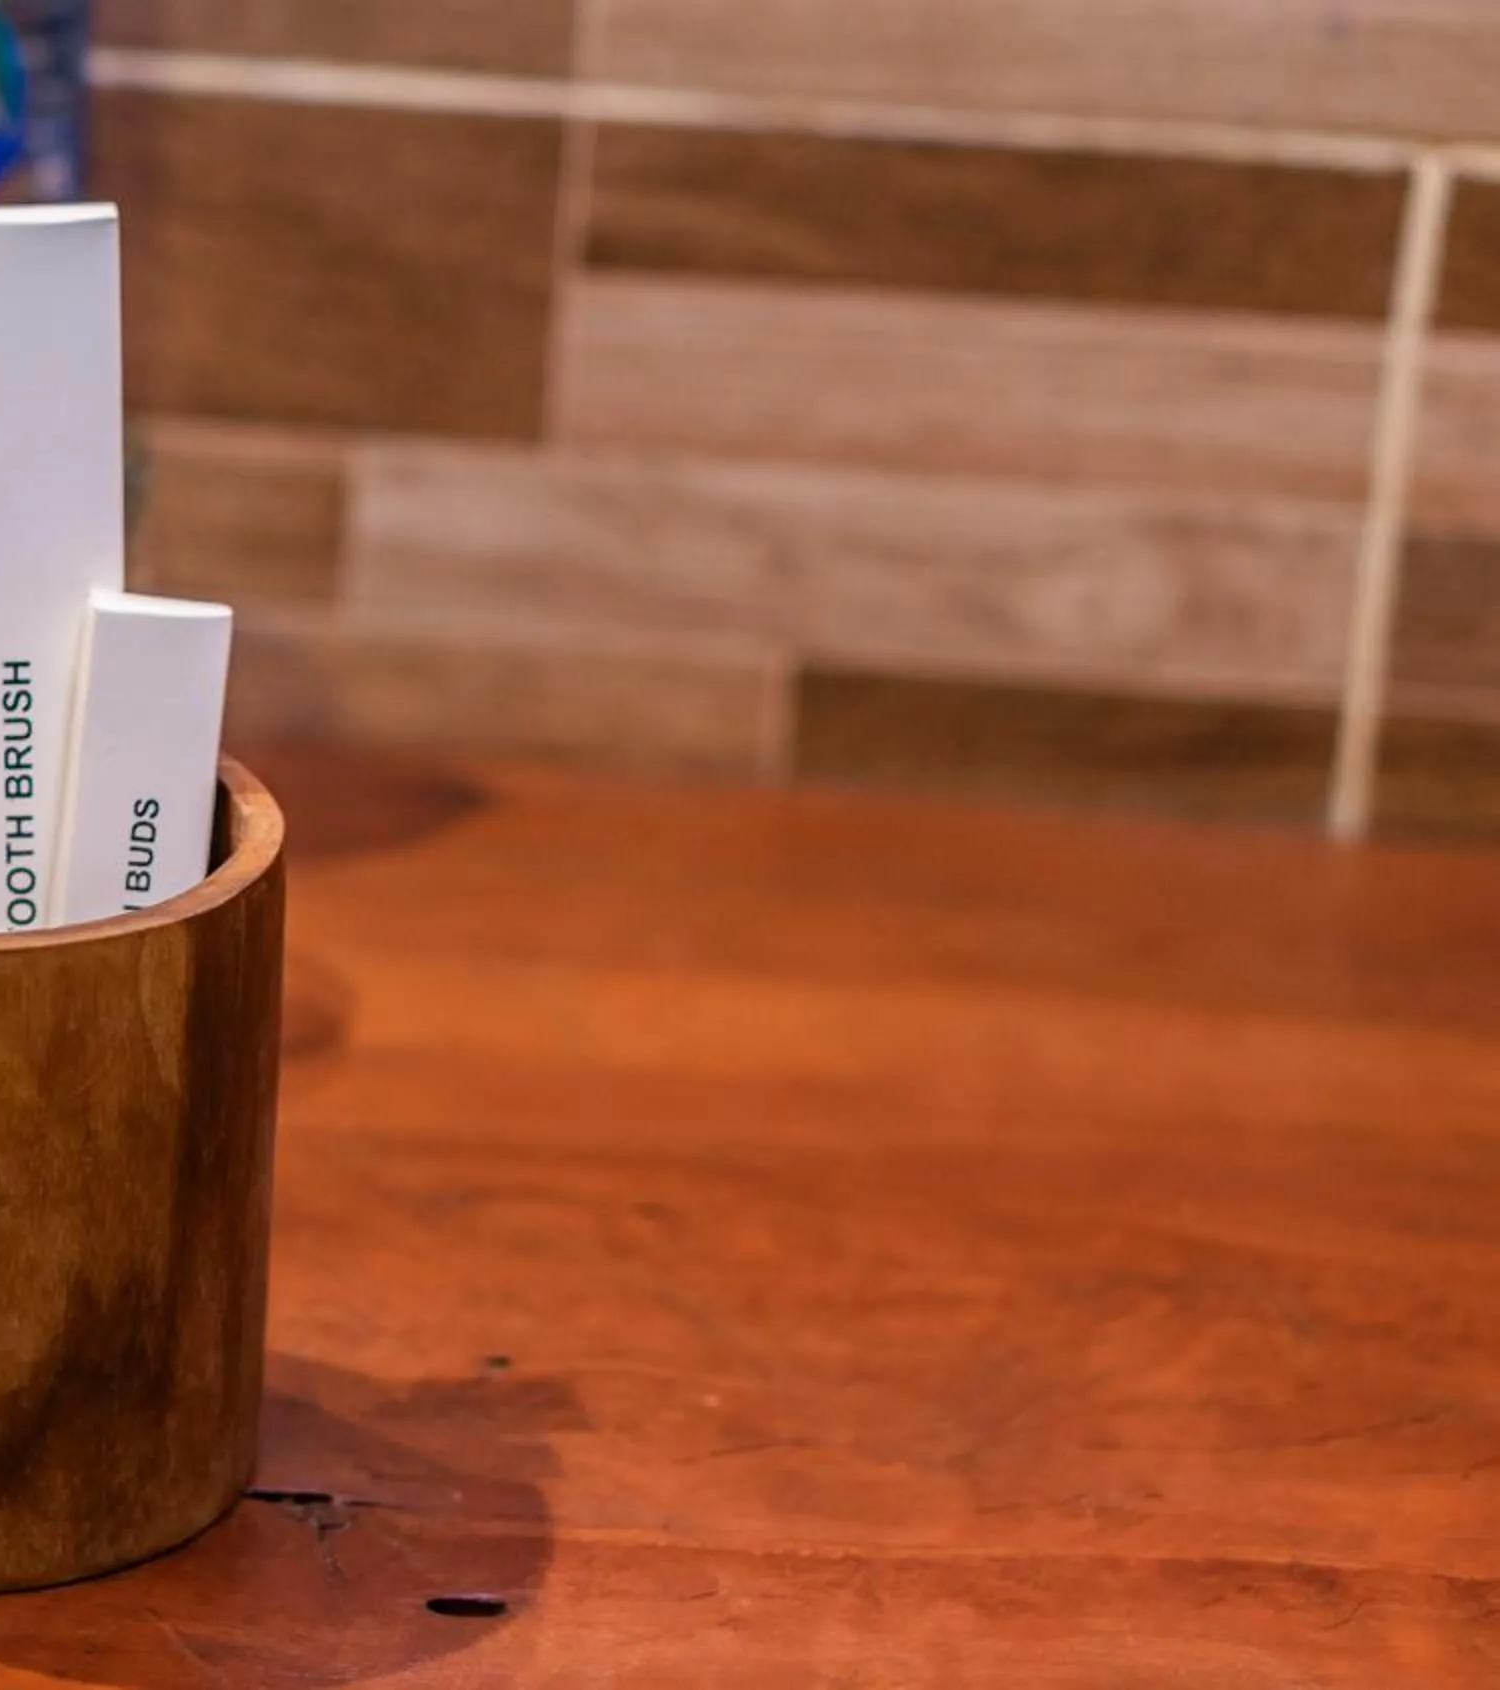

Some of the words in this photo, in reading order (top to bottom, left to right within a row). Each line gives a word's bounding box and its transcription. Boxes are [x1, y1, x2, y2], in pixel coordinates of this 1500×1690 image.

[1, 660, 33, 800] BRUSH
[5, 815, 37, 929] OOTH
[124, 798, 160, 893] BUDS
